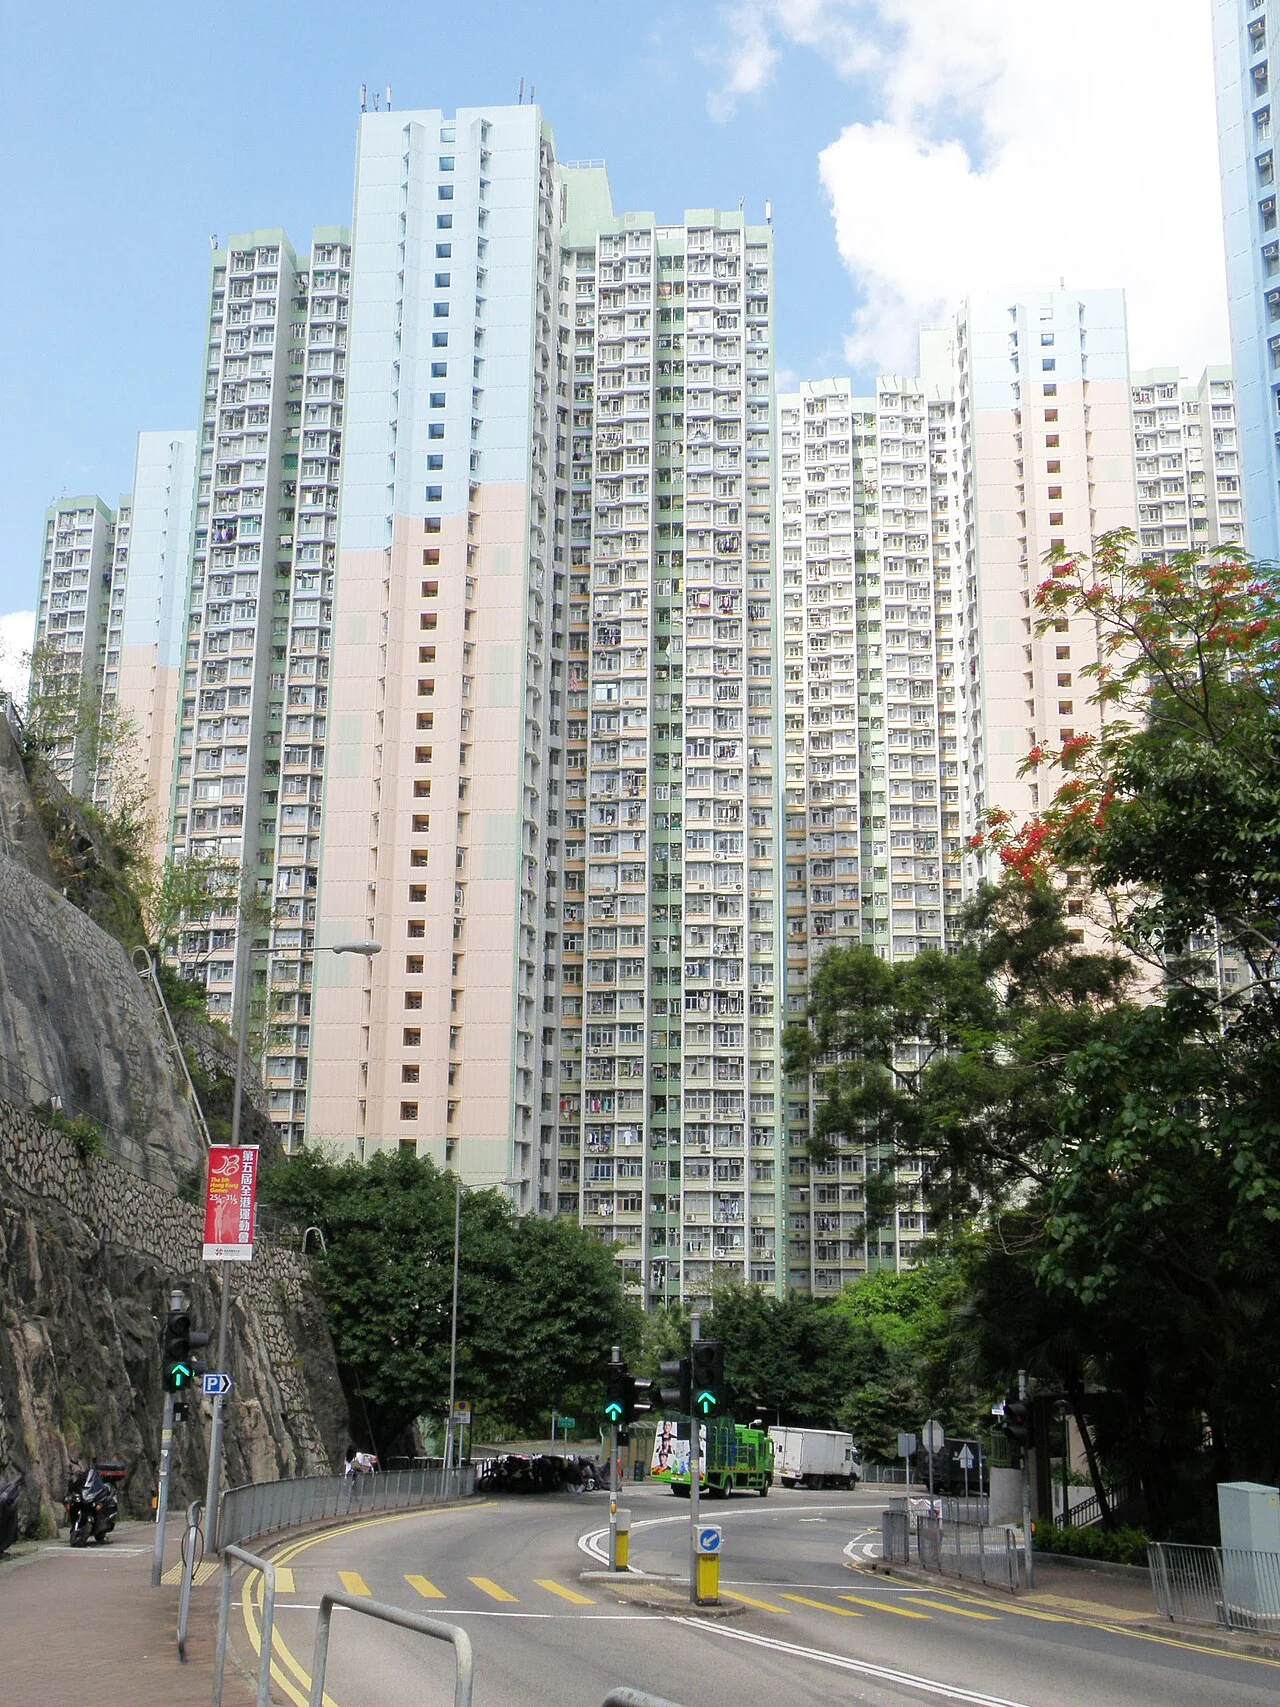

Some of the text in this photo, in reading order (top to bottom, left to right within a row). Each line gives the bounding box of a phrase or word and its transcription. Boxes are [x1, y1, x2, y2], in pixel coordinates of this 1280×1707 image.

[239, 1150, 254, 1243] 第五屆全港運動會
[207, 1377, 218, 1391] P
